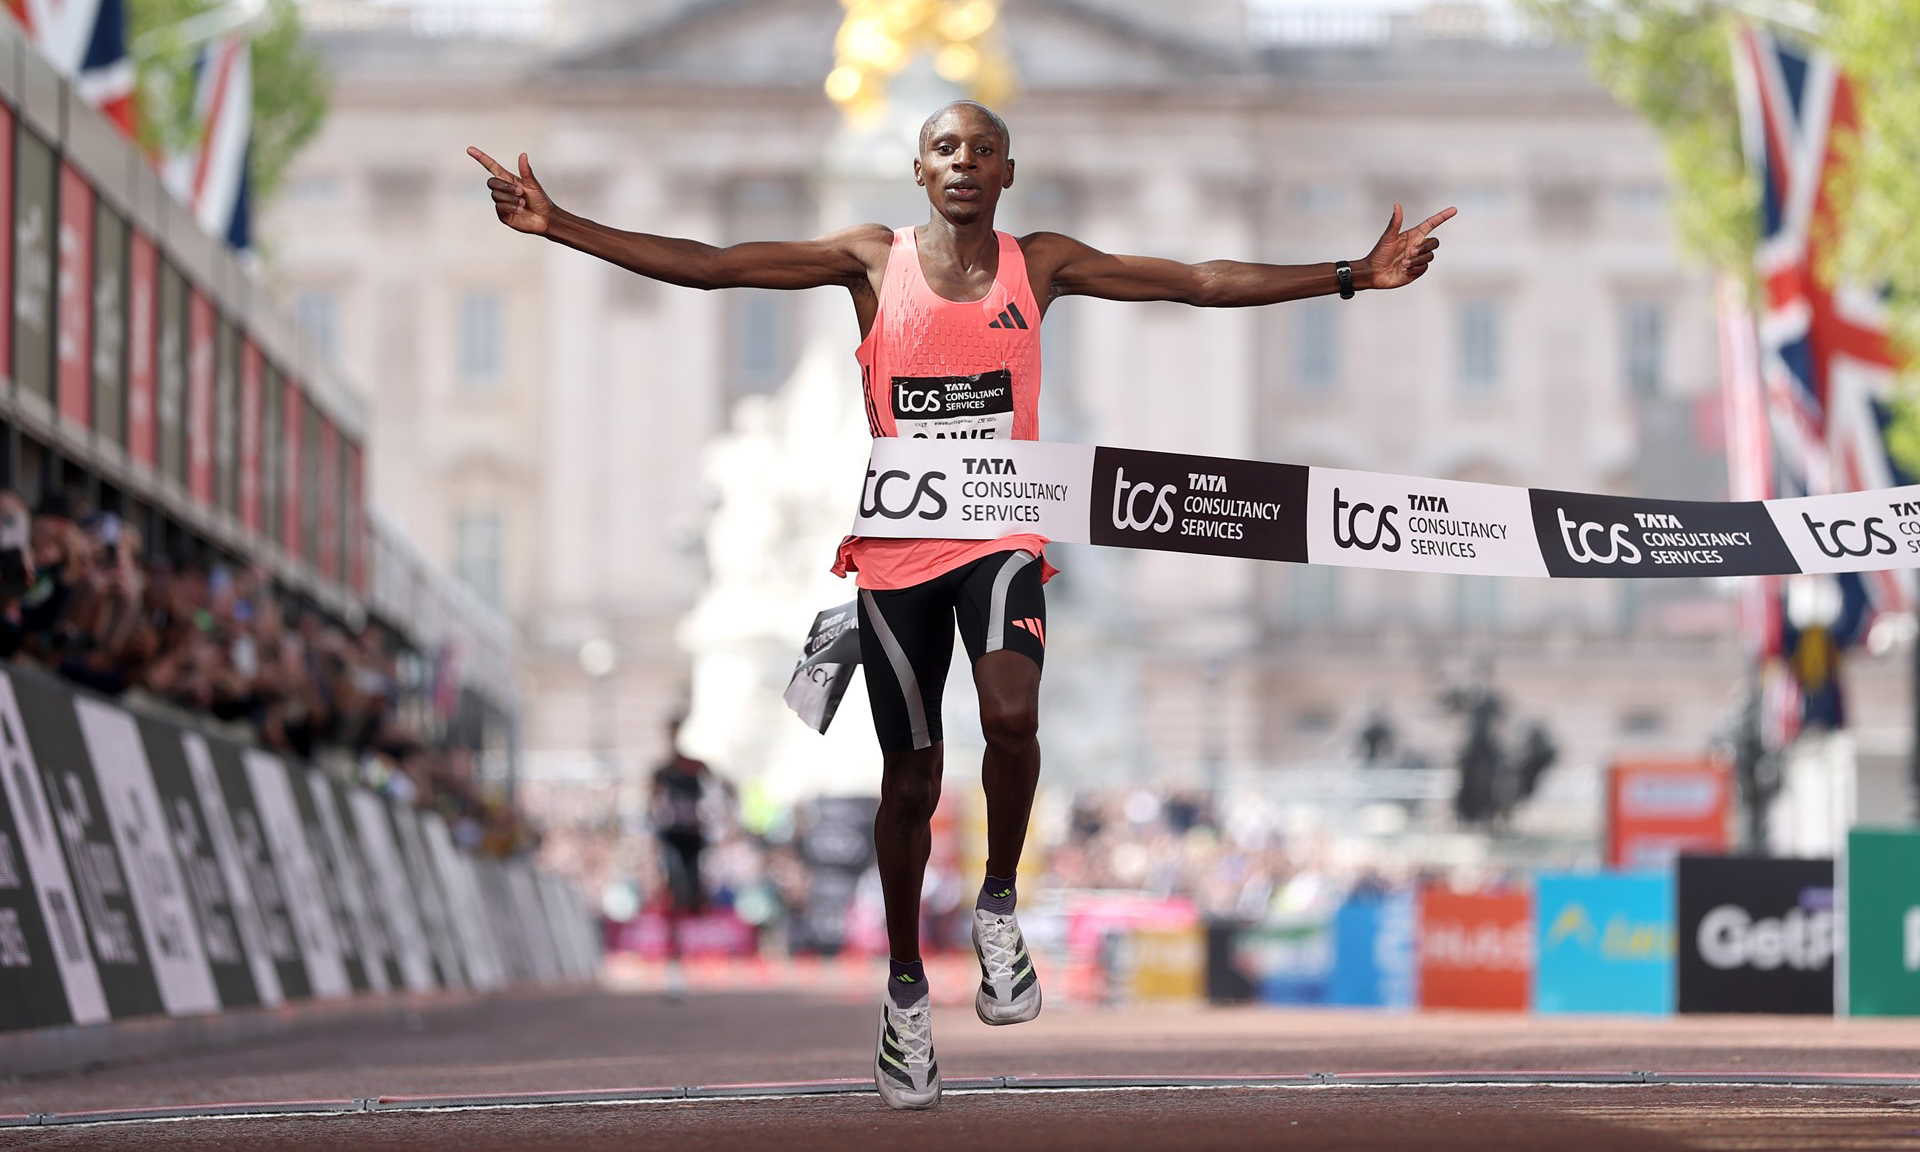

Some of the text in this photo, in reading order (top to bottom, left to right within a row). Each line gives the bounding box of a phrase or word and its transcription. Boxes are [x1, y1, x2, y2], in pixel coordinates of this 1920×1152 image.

[944, 383, 972, 391] TATA
[945, 387, 1005, 402] CONSULTANCY
[898, 384, 941, 412] tcs
[945, 400, 985, 412] SERVICES
[962, 458, 1017, 475] TATA
[860, 458, 947, 520] tcs
[961, 481, 1068, 502] CONSULTANCY
[1188, 473, 1228, 493] TATA
[1112, 466, 1178, 534] tcs
[1183, 496, 1281, 521] CONSULTANCY
[1407, 494, 1449, 514] TATA
[961, 505, 1040, 522] SERVICES
[1333, 487, 1402, 553] tcs
[1633, 513, 1684, 529] TATA
[1180, 518, 1244, 541] SERVICES
[1408, 516, 1508, 540] CONSULTANCY
[1557, 507, 1642, 565] tcs
[1801, 512, 1897, 558] tcs
[1410, 539, 1477, 559] SERVICES
[1642, 532, 1752, 547] CONSULTANCY
[1650, 551, 1724, 565] SERVICES
